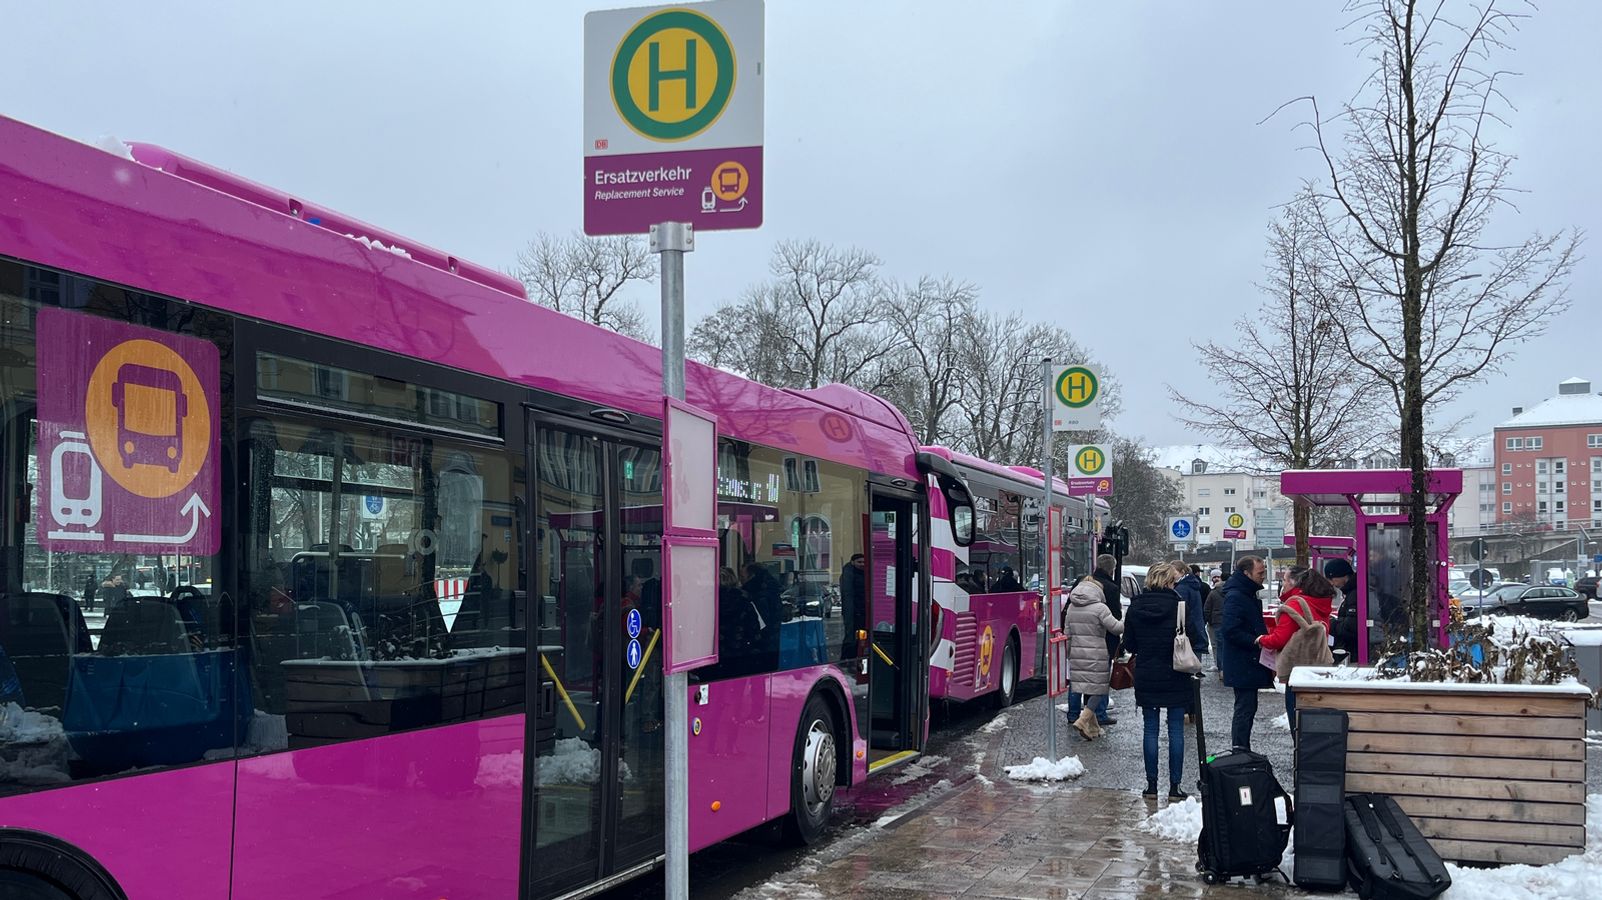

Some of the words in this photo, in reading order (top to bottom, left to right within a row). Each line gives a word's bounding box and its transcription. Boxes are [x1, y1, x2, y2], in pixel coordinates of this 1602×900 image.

[648, 38, 697, 112] H
[595, 140, 609, 149] DB
[595, 166, 692, 185] Ersatzverkehr
[594, 189, 651, 202] Replacement
[652, 186, 685, 197] Service
[1068, 376, 1085, 399] H
[1084, 452, 1096, 469] H
[1232, 517, 1239, 525] H
